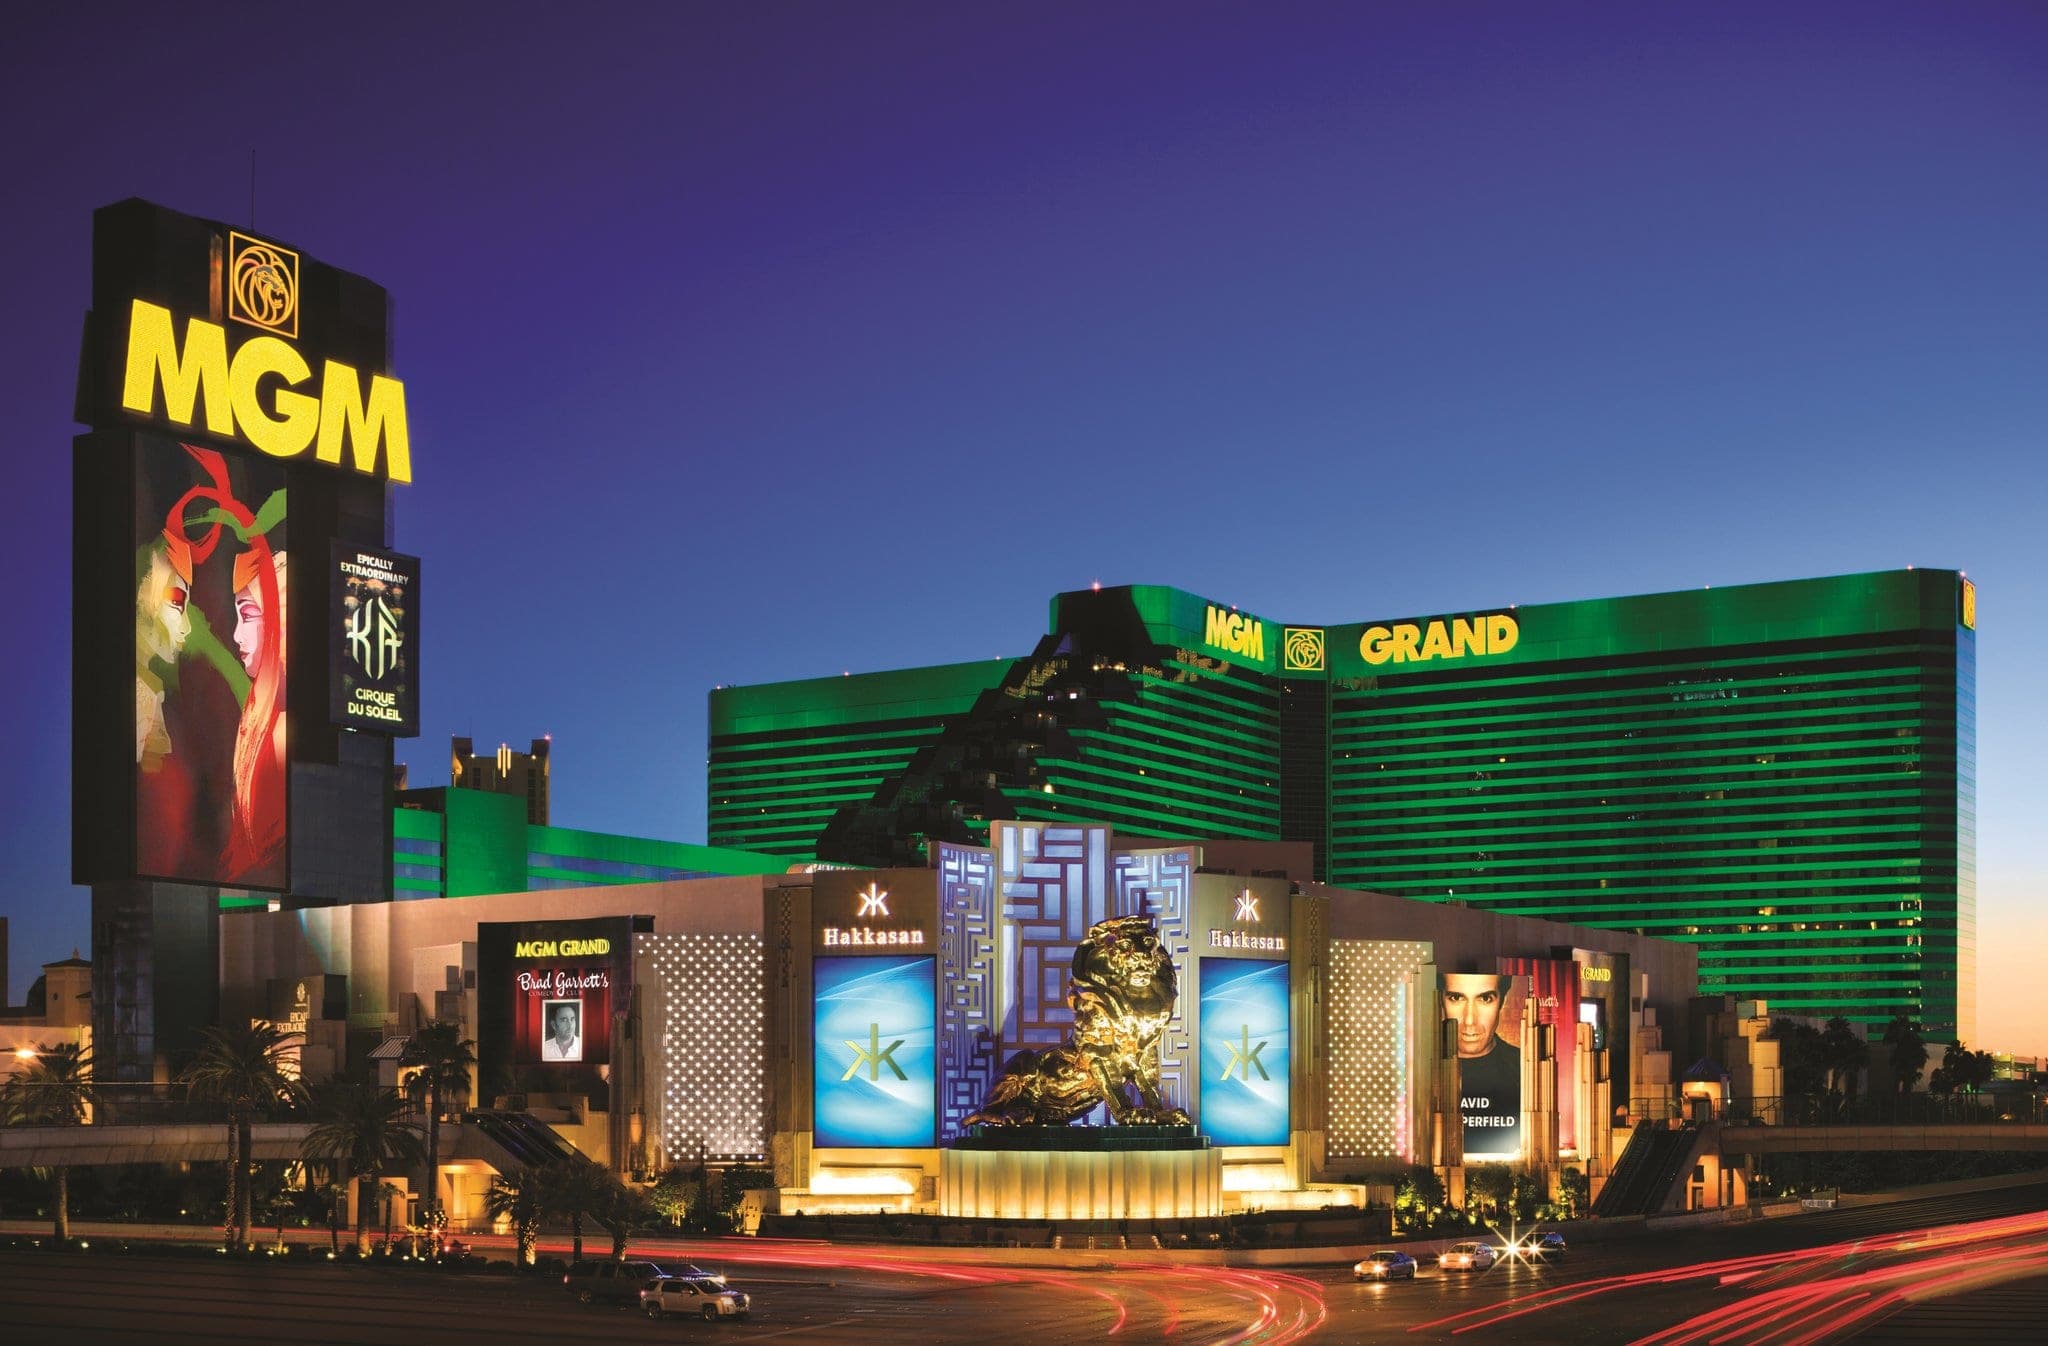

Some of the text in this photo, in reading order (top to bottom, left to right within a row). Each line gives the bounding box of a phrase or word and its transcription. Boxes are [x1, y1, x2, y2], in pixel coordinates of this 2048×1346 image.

[123, 299, 411, 483] MGM
[357, 554, 394, 570] EPICALLY
[340, 562, 409, 585] EXTRAORDINARY
[1205, 606, 1519, 665] MGM GRAND
[355, 688, 395, 707] CIRQUE
[348, 702, 402, 722] DU SOLEIL
[824, 927, 923, 946] Hakkasan
[1208, 930, 1286, 950] Hakkasan
[515, 938, 610, 957] MGM GRAND
[517, 972, 609, 996] Brad Garrett's
[1460, 1097, 1490, 1109] AVID
